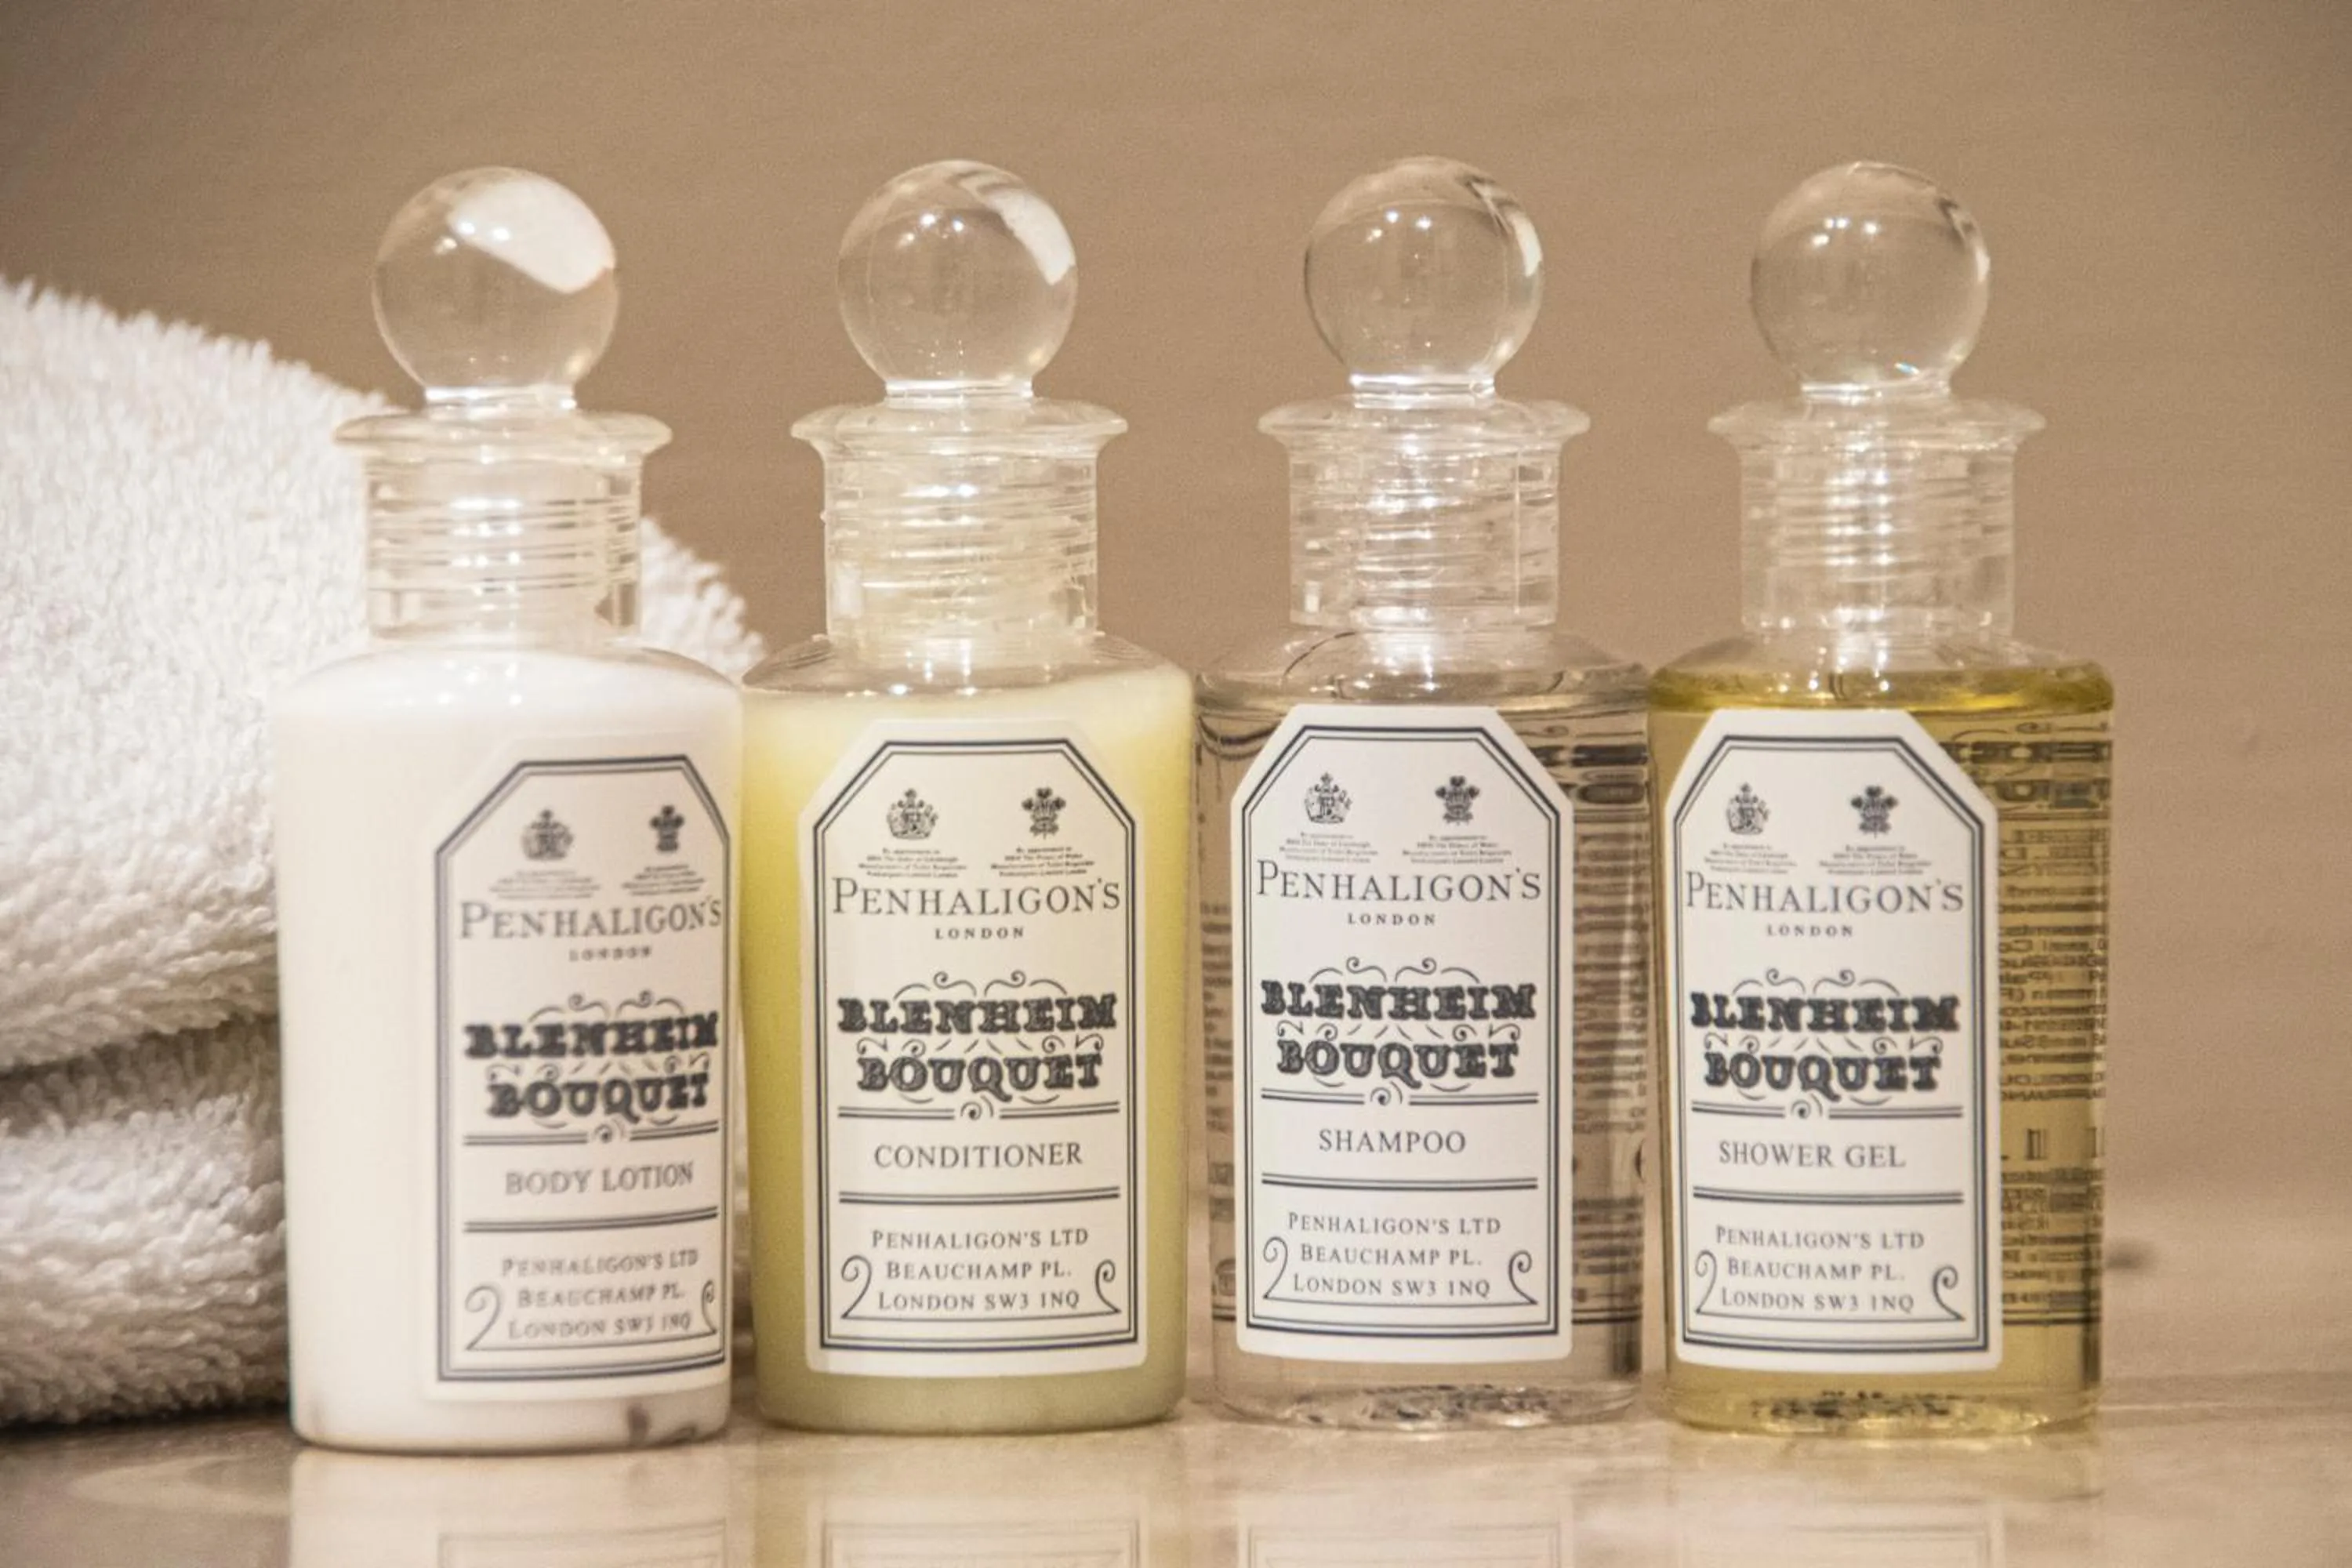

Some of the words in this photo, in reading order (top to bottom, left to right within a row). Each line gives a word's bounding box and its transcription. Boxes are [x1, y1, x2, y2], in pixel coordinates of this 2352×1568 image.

[1257, 859, 1541, 902] PENHALIGON'S
[1686, 870, 1964, 914] PENHALIGON'S
[832, 877, 1120, 916] PENHALIGON'S
[461, 895, 722, 940] PENHALIGON'S
[1348, 913, 1436, 926] LONDON
[935, 927, 1025, 940] LONDON
[1766, 924, 1853, 937] LONDON
[569, 946, 652, 962] LONDON
[1261, 979, 1537, 1020] BLENHEIM
[1690, 991, 1960, 1033] BLENHEIM
[837, 993, 1116, 1035] BLENHEIM
[464, 1012, 718, 1059] BLENHEIM
[1276, 1039, 1519, 1090] BOUQUET
[1704, 1052, 1940, 1102] BOUQUET
[857, 1053, 1103, 1102] BOUQUET
[486, 1073, 709, 1123] BOUQUET
[1319, 1129, 1466, 1152] SHAMPOO
[874, 1142, 1083, 1168] CONDITIONER
[1719, 1140, 1833, 1167] SHOWER
[1846, 1145, 1906, 1168] GEL
[505, 1171, 592, 1196] BODY
[601, 1161, 694, 1192] LOTION
[1288, 1211, 1450, 1235] PENHALIGON'S
[1459, 1217, 1501, 1235] LTD
[871, 1229, 1041, 1250] PENHALIGON'S
[1051, 1229, 1089, 1247] LTD
[1715, 1225, 1871, 1250] PENHALIGON'S
[1881, 1232, 1925, 1250] LTD
[502, 1254, 663, 1277] PENHALIGON'S
[669, 1249, 699, 1269] LTD
[1301, 1243, 1440, 1265] BEAUCHAMP
[1449, 1249, 1483, 1265] PL.
[886, 1261, 1033, 1280] BEAUCHAMP
[1040, 1261, 1072, 1278] PL.
[1727, 1258, 1862, 1280] BEAUCHAMP
[1871, 1264, 1906, 1281] PL.
[518, 1283, 655, 1308] BEAUCHAMP
[1294, 1272, 1382, 1295] LONDON
[1392, 1279, 1437, 1297] SW3
[878, 1291, 975, 1311] LONDON
[984, 1294, 1029, 1311] SW3
[1722, 1287, 1804, 1308] LONDON
[1814, 1294, 1859, 1310] SW3
[508, 1319, 605, 1340] LONDON
